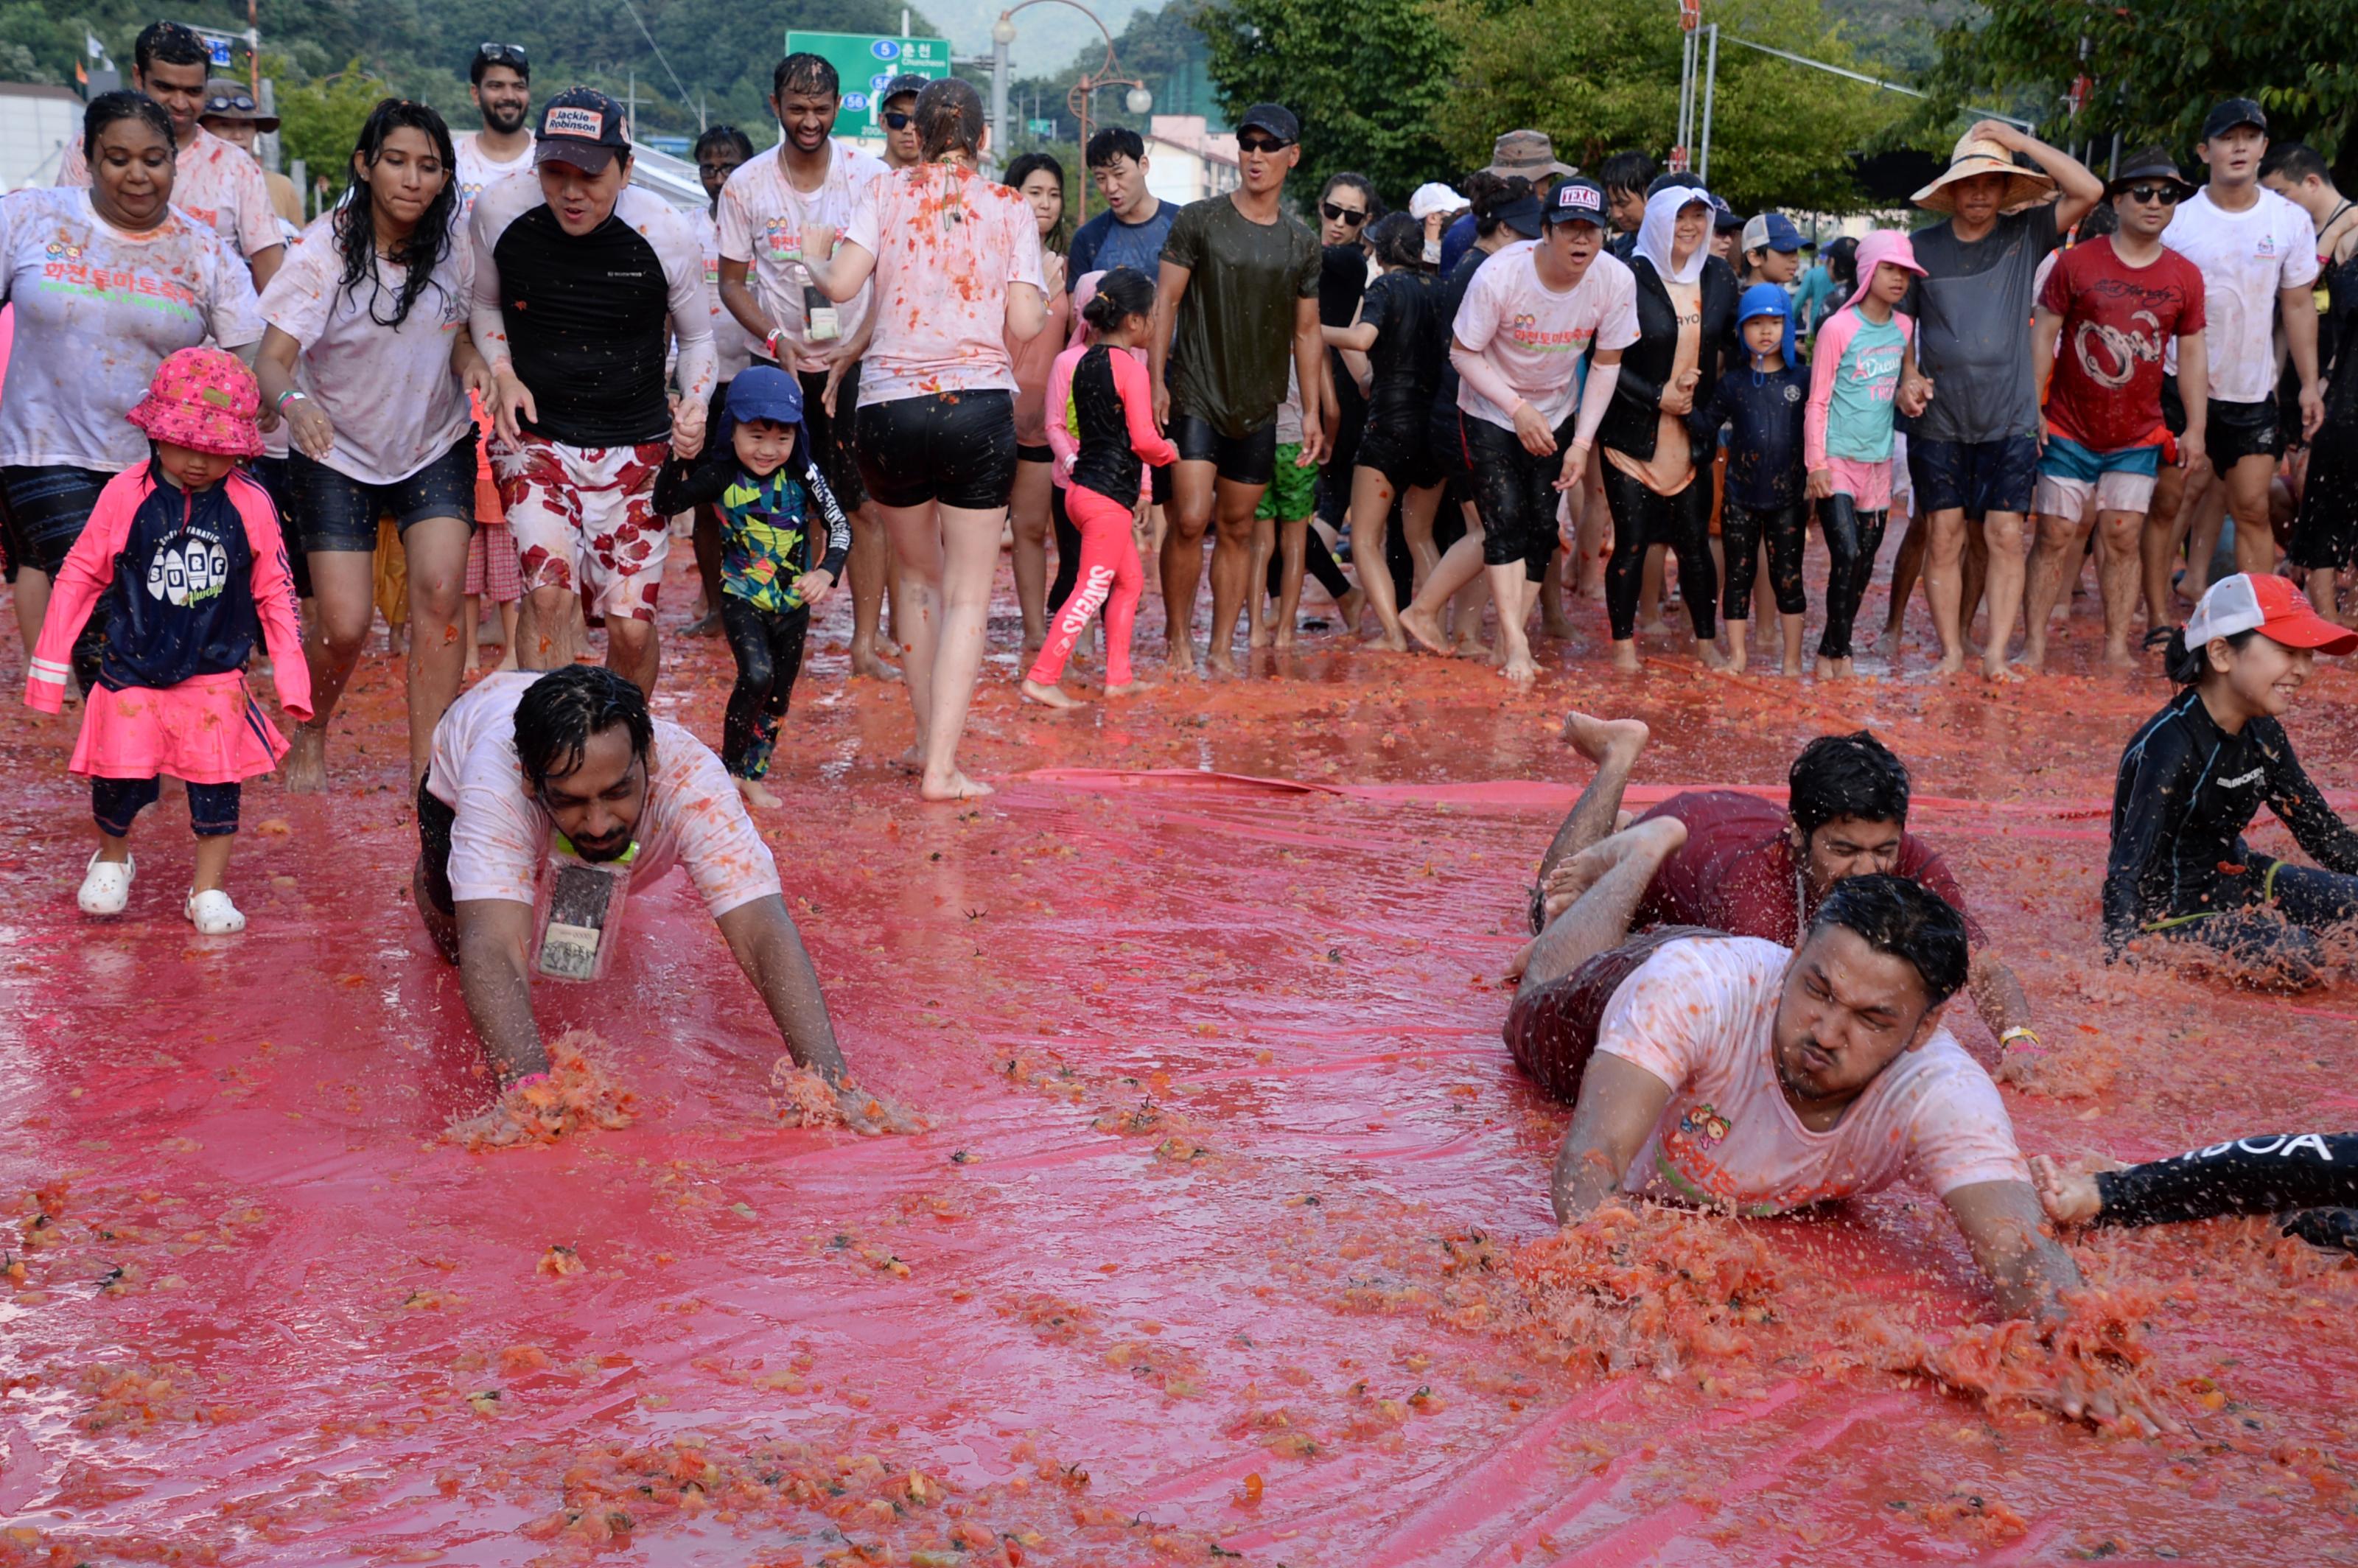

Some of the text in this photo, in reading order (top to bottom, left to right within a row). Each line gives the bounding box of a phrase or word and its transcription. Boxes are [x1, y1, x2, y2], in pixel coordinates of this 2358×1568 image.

[881, 43, 890, 56] 5
[847, 96, 864, 108] 56
[556, 111, 590, 122] Jackie
[549, 119, 596, 132] Robinson
[1564, 189, 1597, 206] TEXAS
[186, 525, 220, 543] FANATIC
[150, 556, 224, 587] SURF
